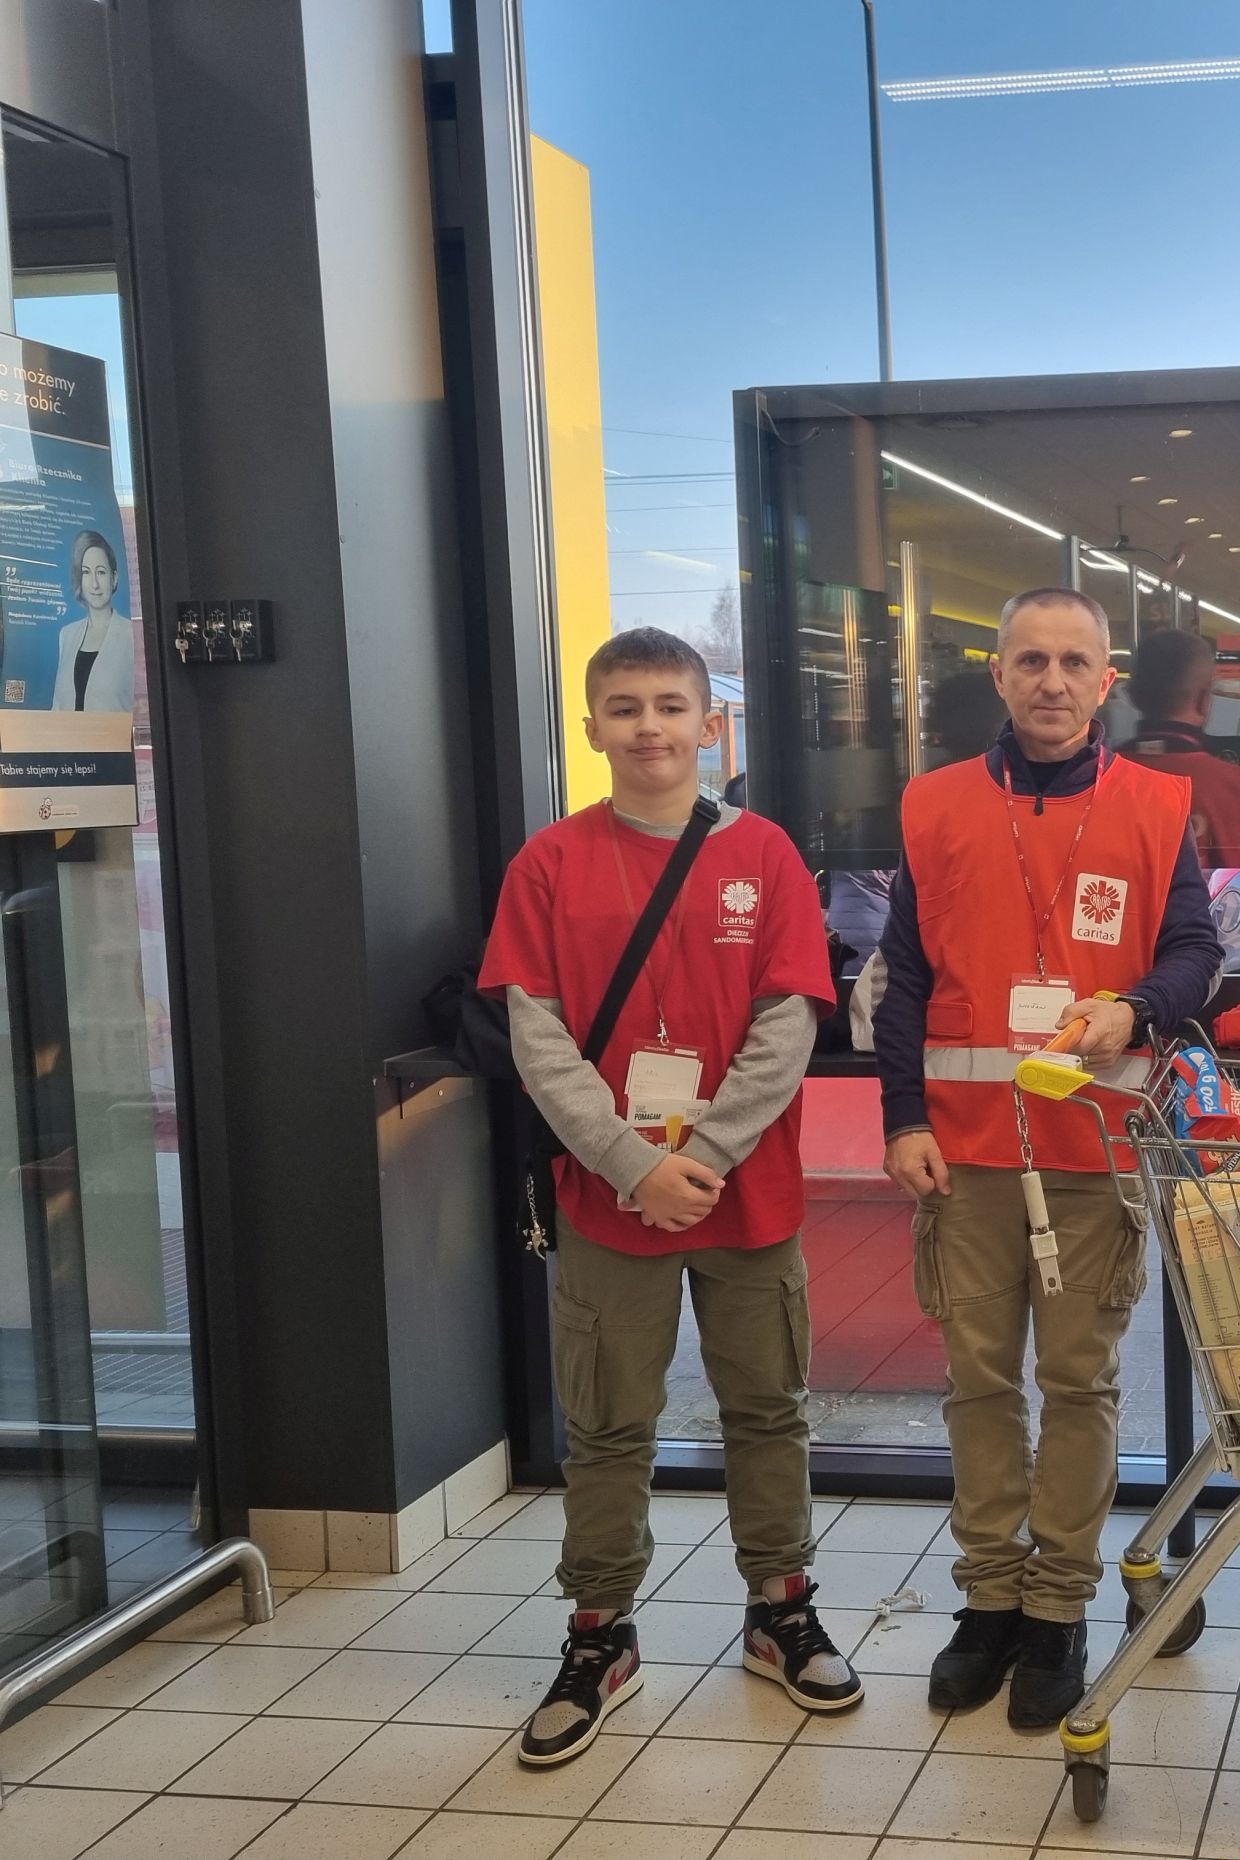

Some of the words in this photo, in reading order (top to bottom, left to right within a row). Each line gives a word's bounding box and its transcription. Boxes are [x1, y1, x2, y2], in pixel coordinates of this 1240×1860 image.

[13, 366, 76, 398] możemy
[13, 388, 67, 415] zrobić.
[36, 463, 83, 482] Rzecznika
[26, 764, 59, 778] stajemy
[61, 764, 73, 776] się
[74, 762, 97, 777] lepsi!
[722, 915, 755, 926] caritas
[1076, 927, 1116, 942] caritas
